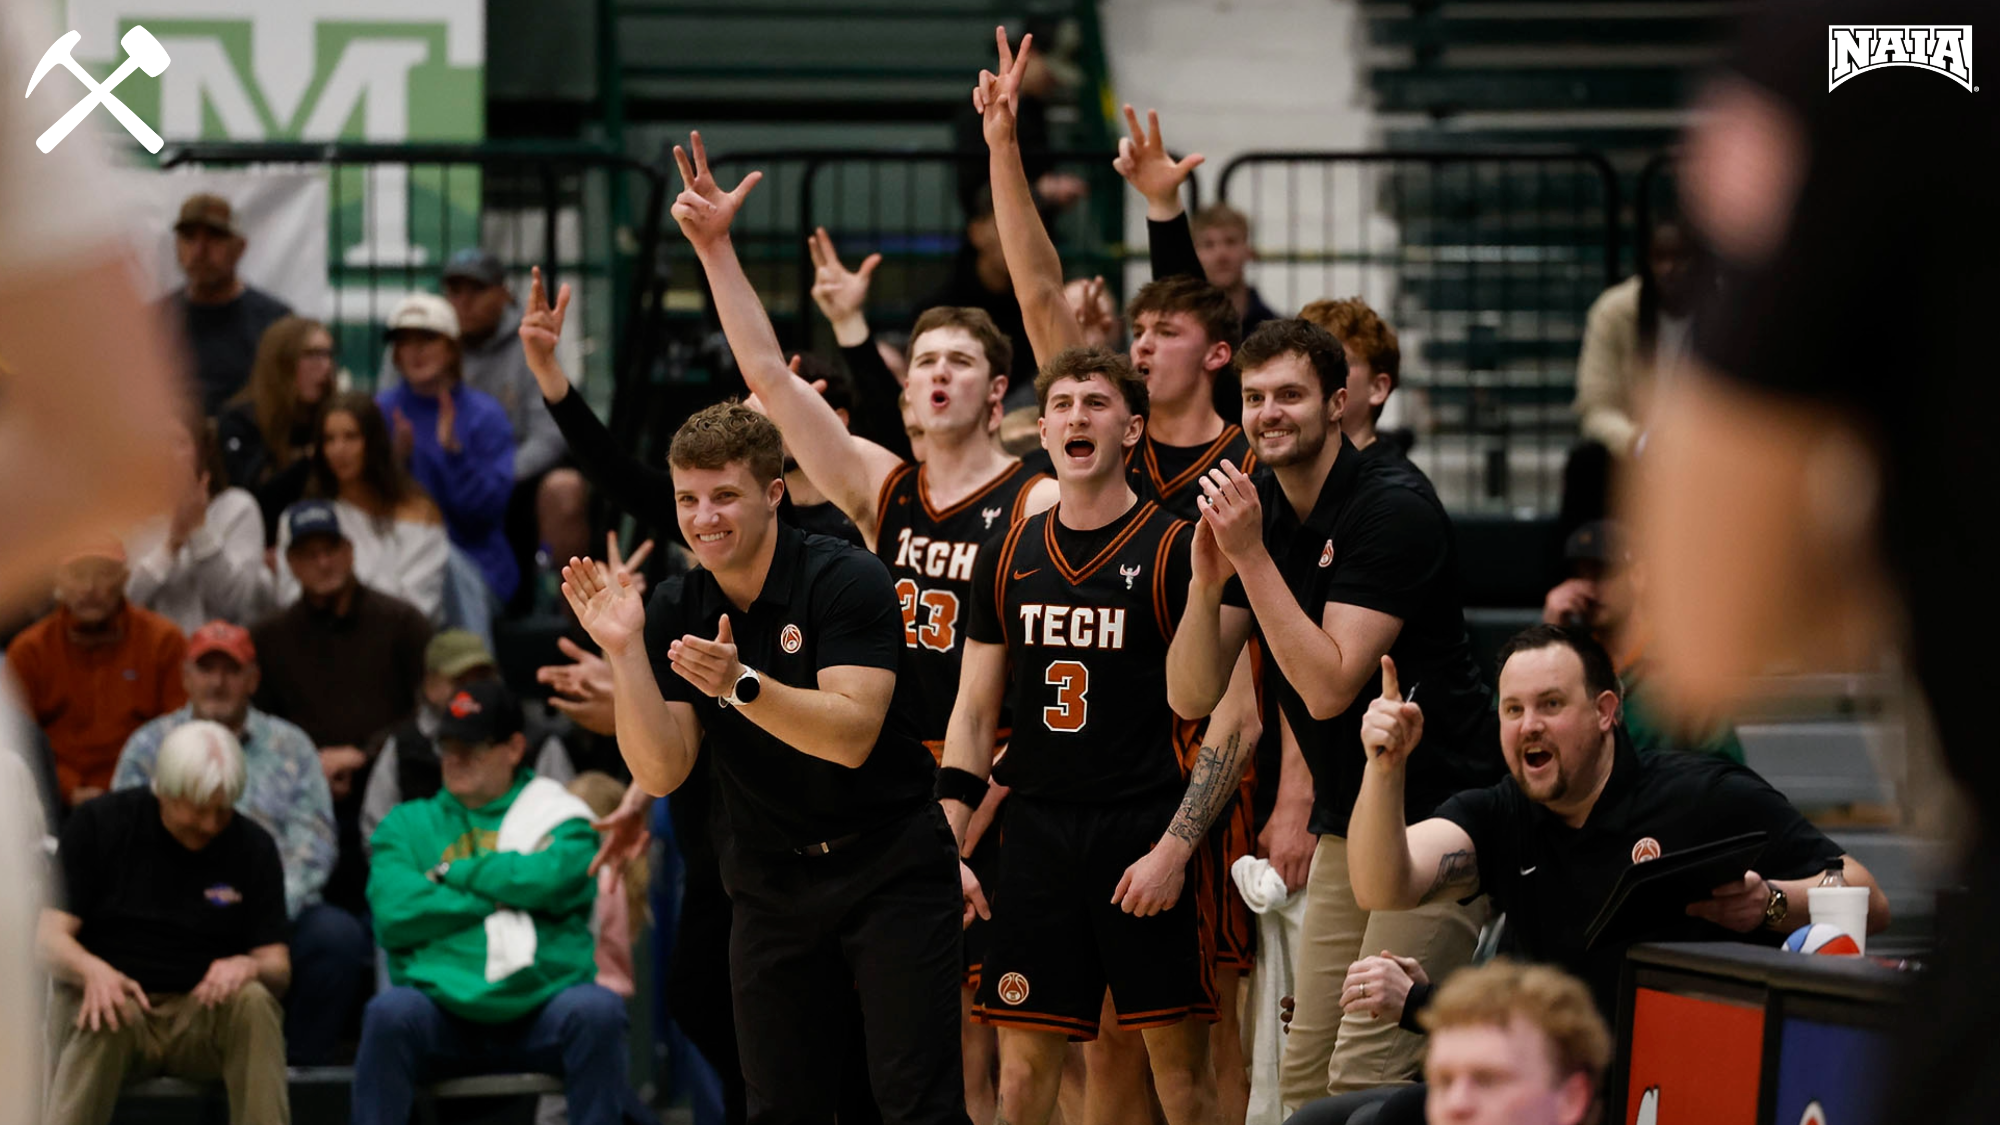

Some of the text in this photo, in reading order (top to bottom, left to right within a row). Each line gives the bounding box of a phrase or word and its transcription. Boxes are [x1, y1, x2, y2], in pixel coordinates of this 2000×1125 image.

[894, 578, 960, 653] 23
[1019, 603, 1125, 649] TECH
[1043, 659, 1089, 732] 3
